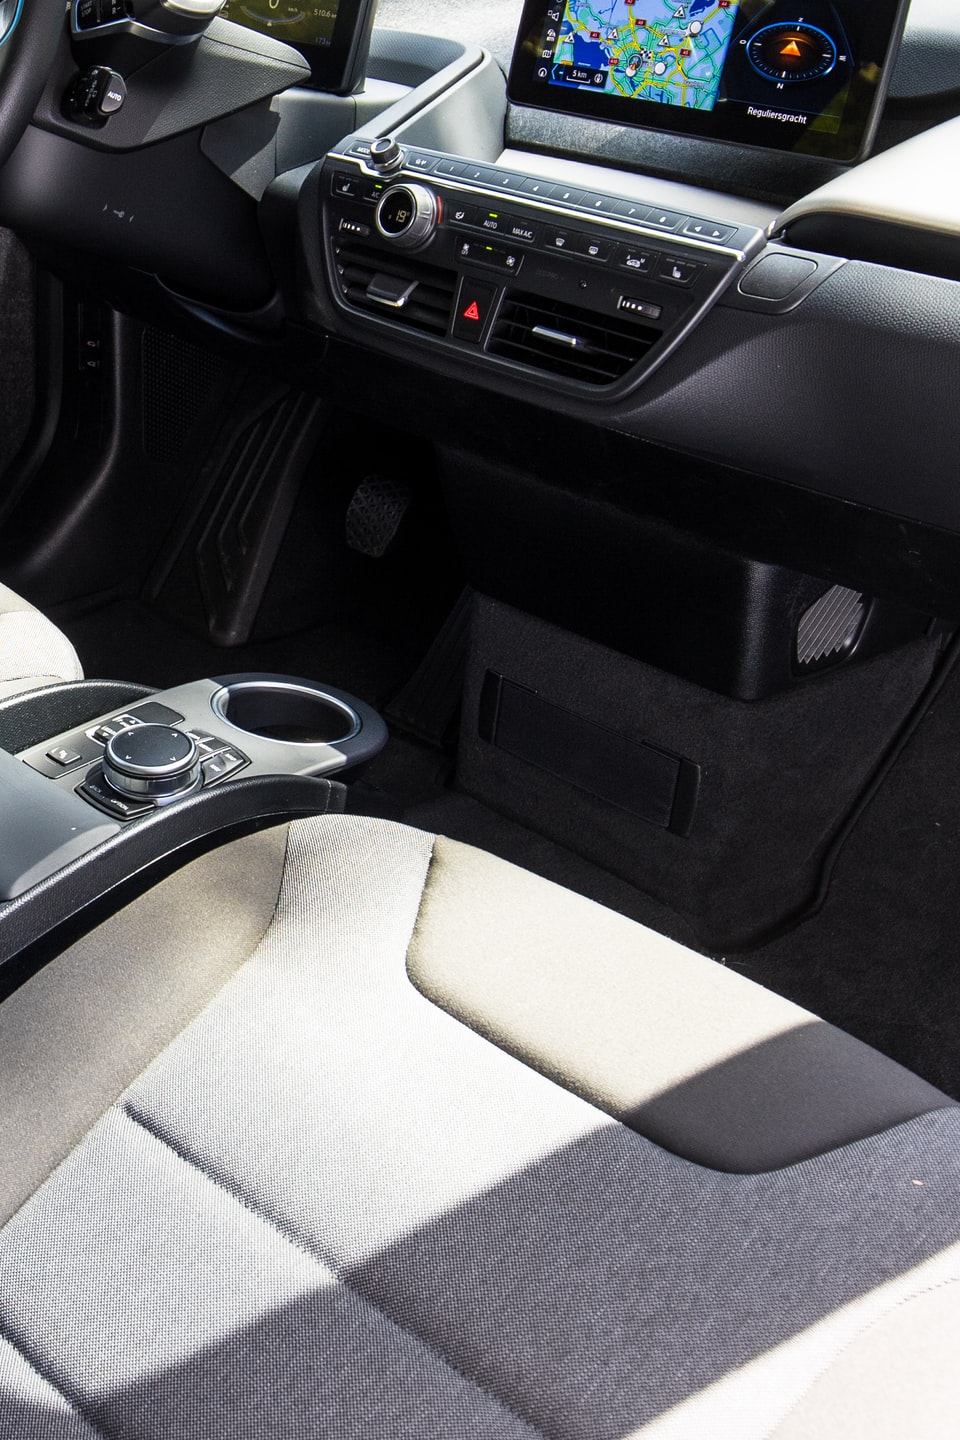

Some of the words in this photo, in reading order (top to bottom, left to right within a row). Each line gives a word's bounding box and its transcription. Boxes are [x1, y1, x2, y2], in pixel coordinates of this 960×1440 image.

[313, 8, 331, 18] 510.6
[572, 69, 577, 77] 5
[578, 70, 587, 78] km
[108, 90, 122, 102] AUTO
[747, 106, 807, 124] Reguliersgracht
[483, 220, 498, 230] AUTO
